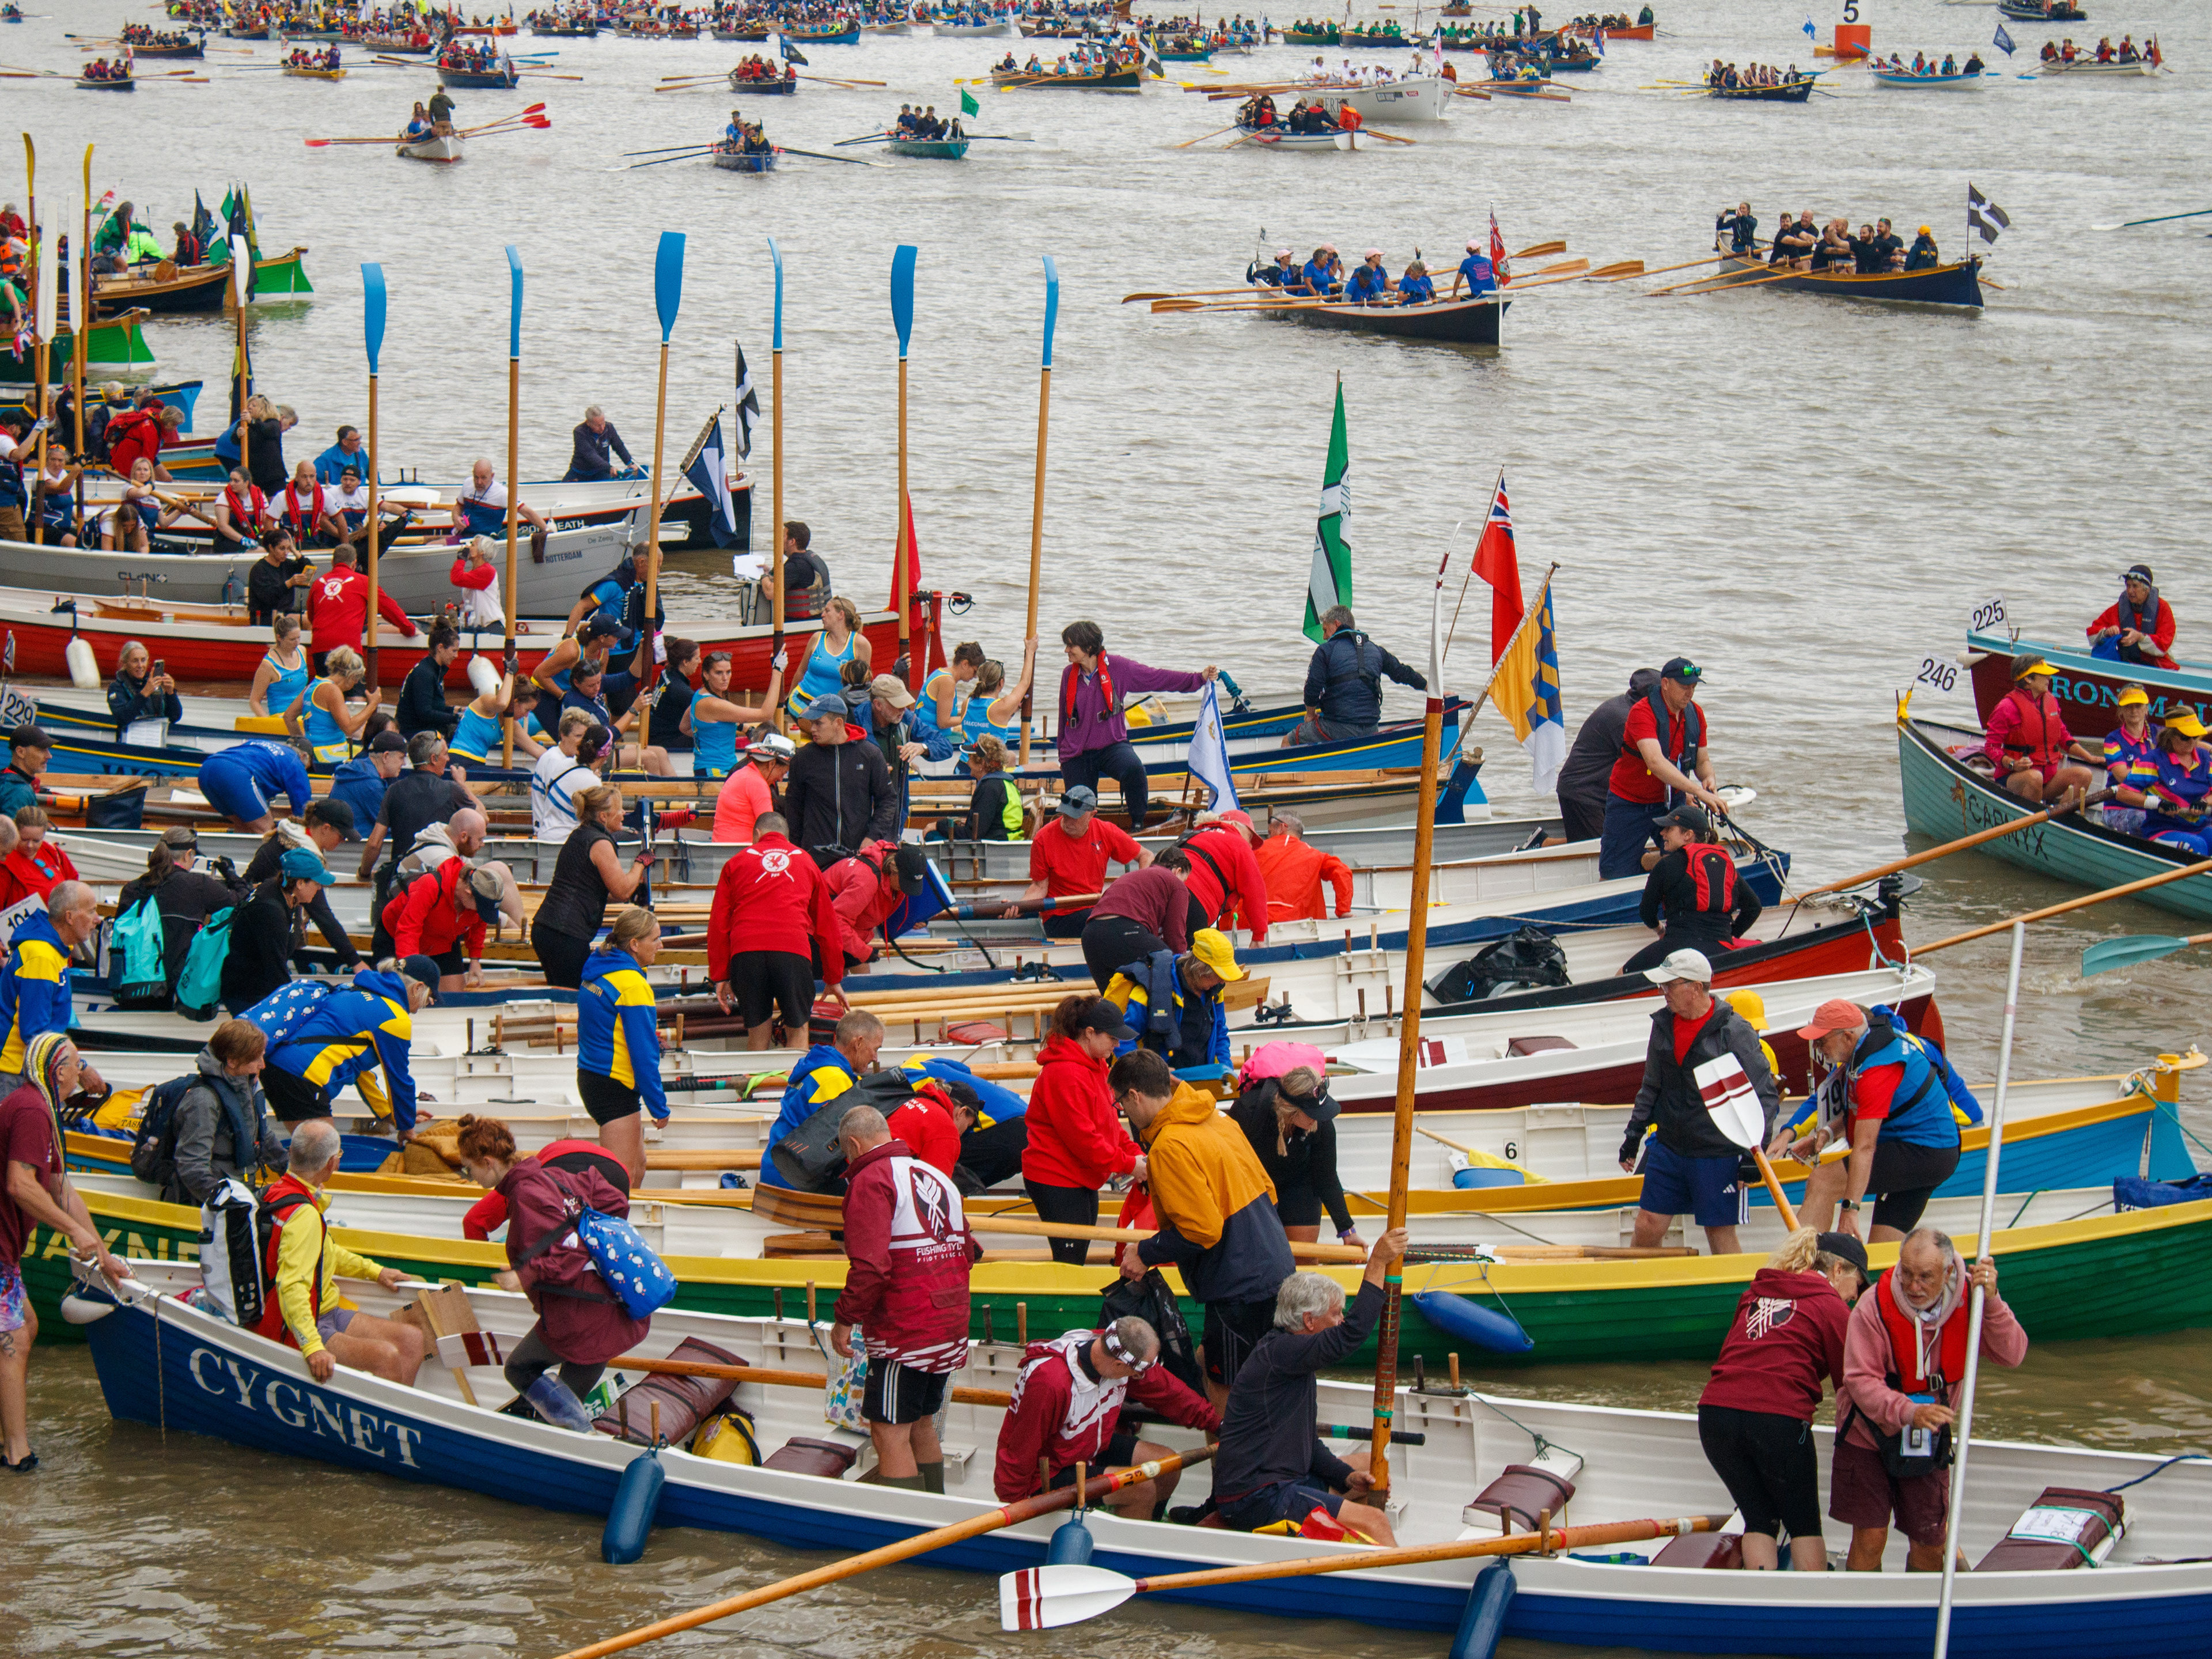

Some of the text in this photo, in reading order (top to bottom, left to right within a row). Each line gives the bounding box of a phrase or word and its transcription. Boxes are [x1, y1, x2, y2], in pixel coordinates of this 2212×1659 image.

[1843, 0, 1859, 23] 5
[521, 519, 585, 533] POEATH
[545, 551, 583, 563] ROTTERDAM
[1972, 600, 2005, 632] 225
[1917, 658, 1957, 691] 246
[4, 694, 33, 725] 229
[963, 719, 990, 728] SALCOMBE
[916, 1103, 929, 1114] SEA
[1505, 1142, 1517, 1160] 6
[190, 1348, 421, 1469] CYGNET
